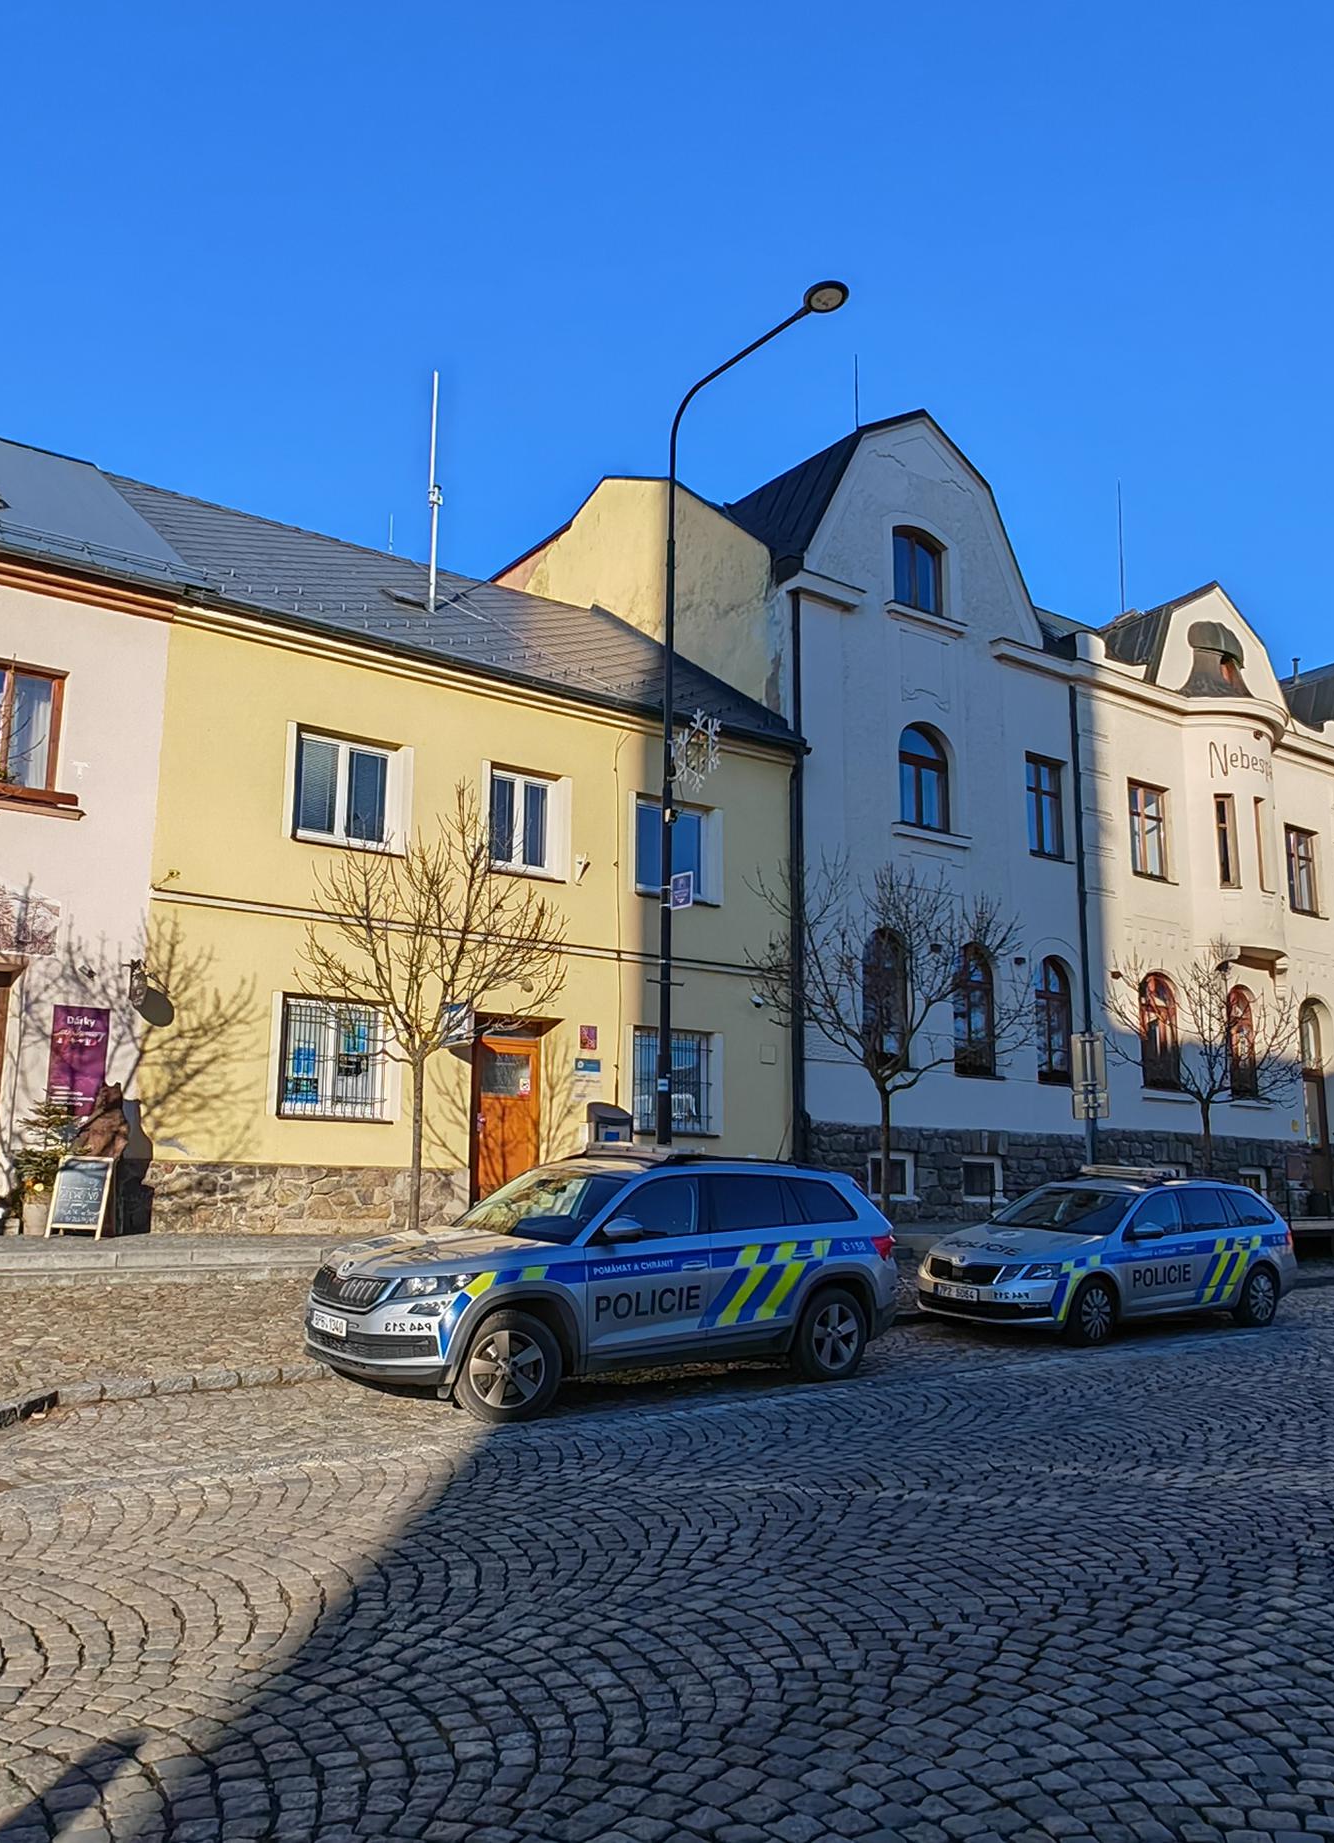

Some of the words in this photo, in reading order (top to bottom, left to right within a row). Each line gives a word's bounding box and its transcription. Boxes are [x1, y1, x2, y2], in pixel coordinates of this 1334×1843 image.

[945, 1240, 1022, 1256] POLICIE
[633, 1262, 640, 1271] A
[1132, 1264, 1191, 1288] POLICIE
[594, 1285, 701, 1322] POLICIE
